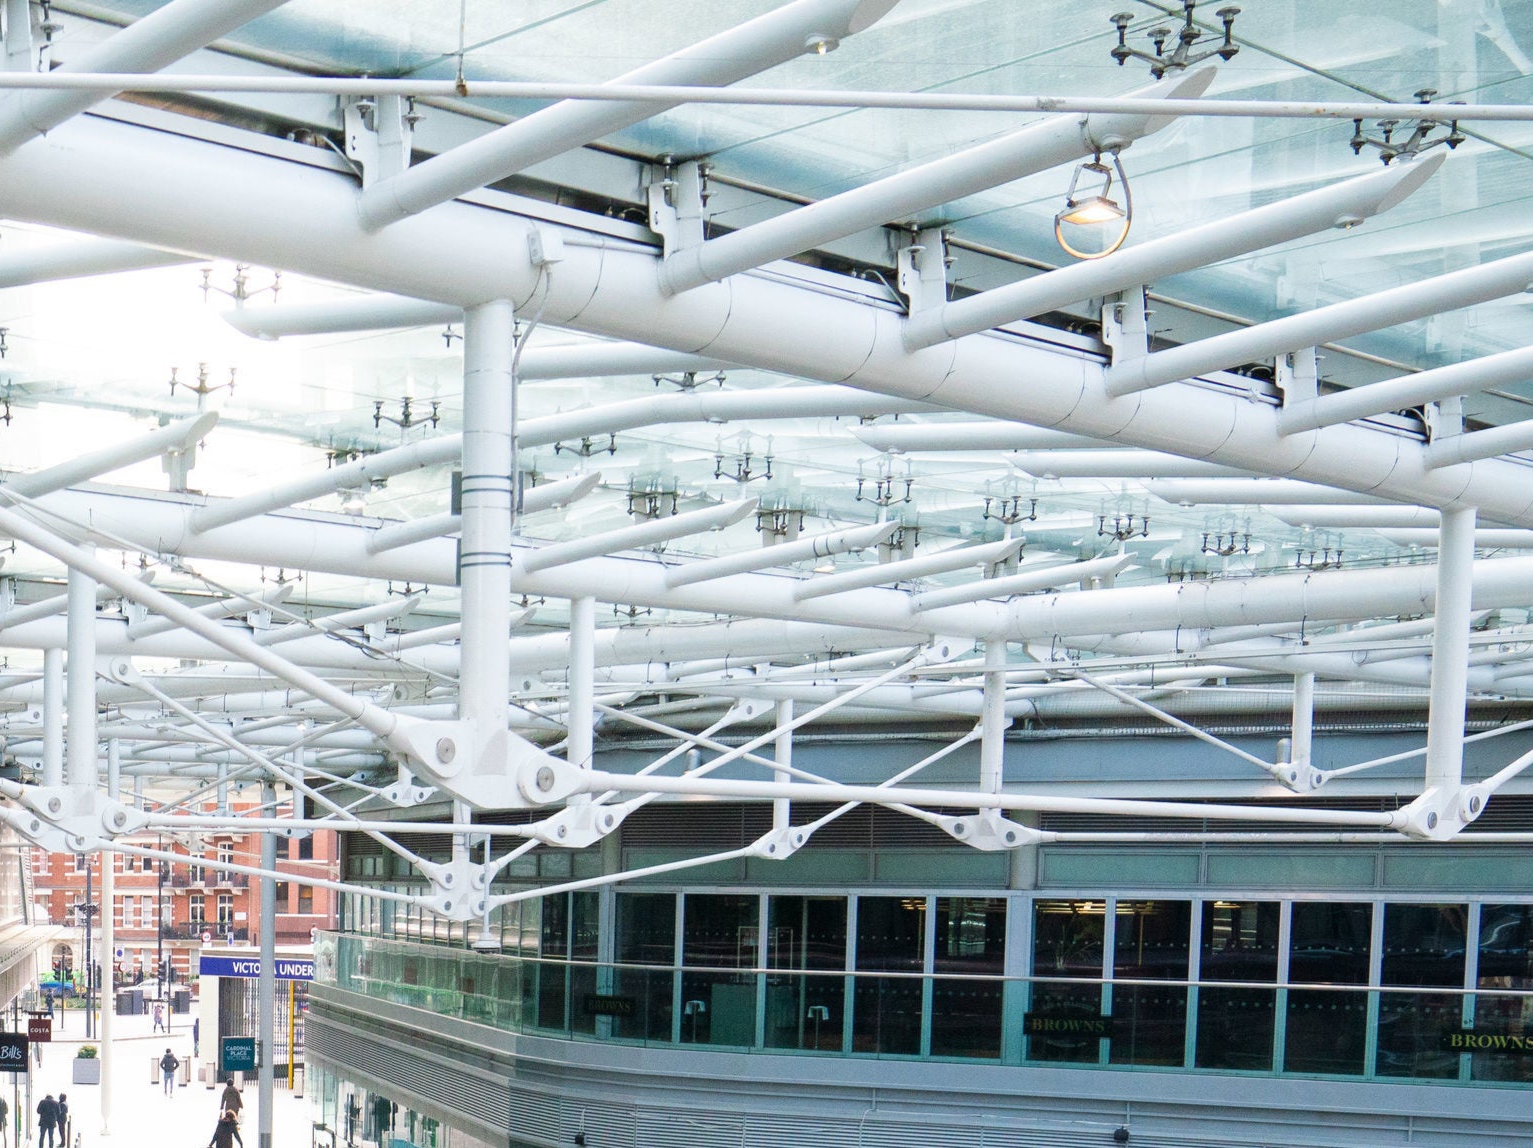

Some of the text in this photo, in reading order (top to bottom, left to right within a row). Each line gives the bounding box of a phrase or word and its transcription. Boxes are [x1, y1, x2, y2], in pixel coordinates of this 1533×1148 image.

[232, 961, 277, 974] VICTO
[1032, 1018, 1105, 1032] BROWNS
[1450, 1033, 1533, 1050] BROWNS
[0, 1045, 22, 1059] Bill's
